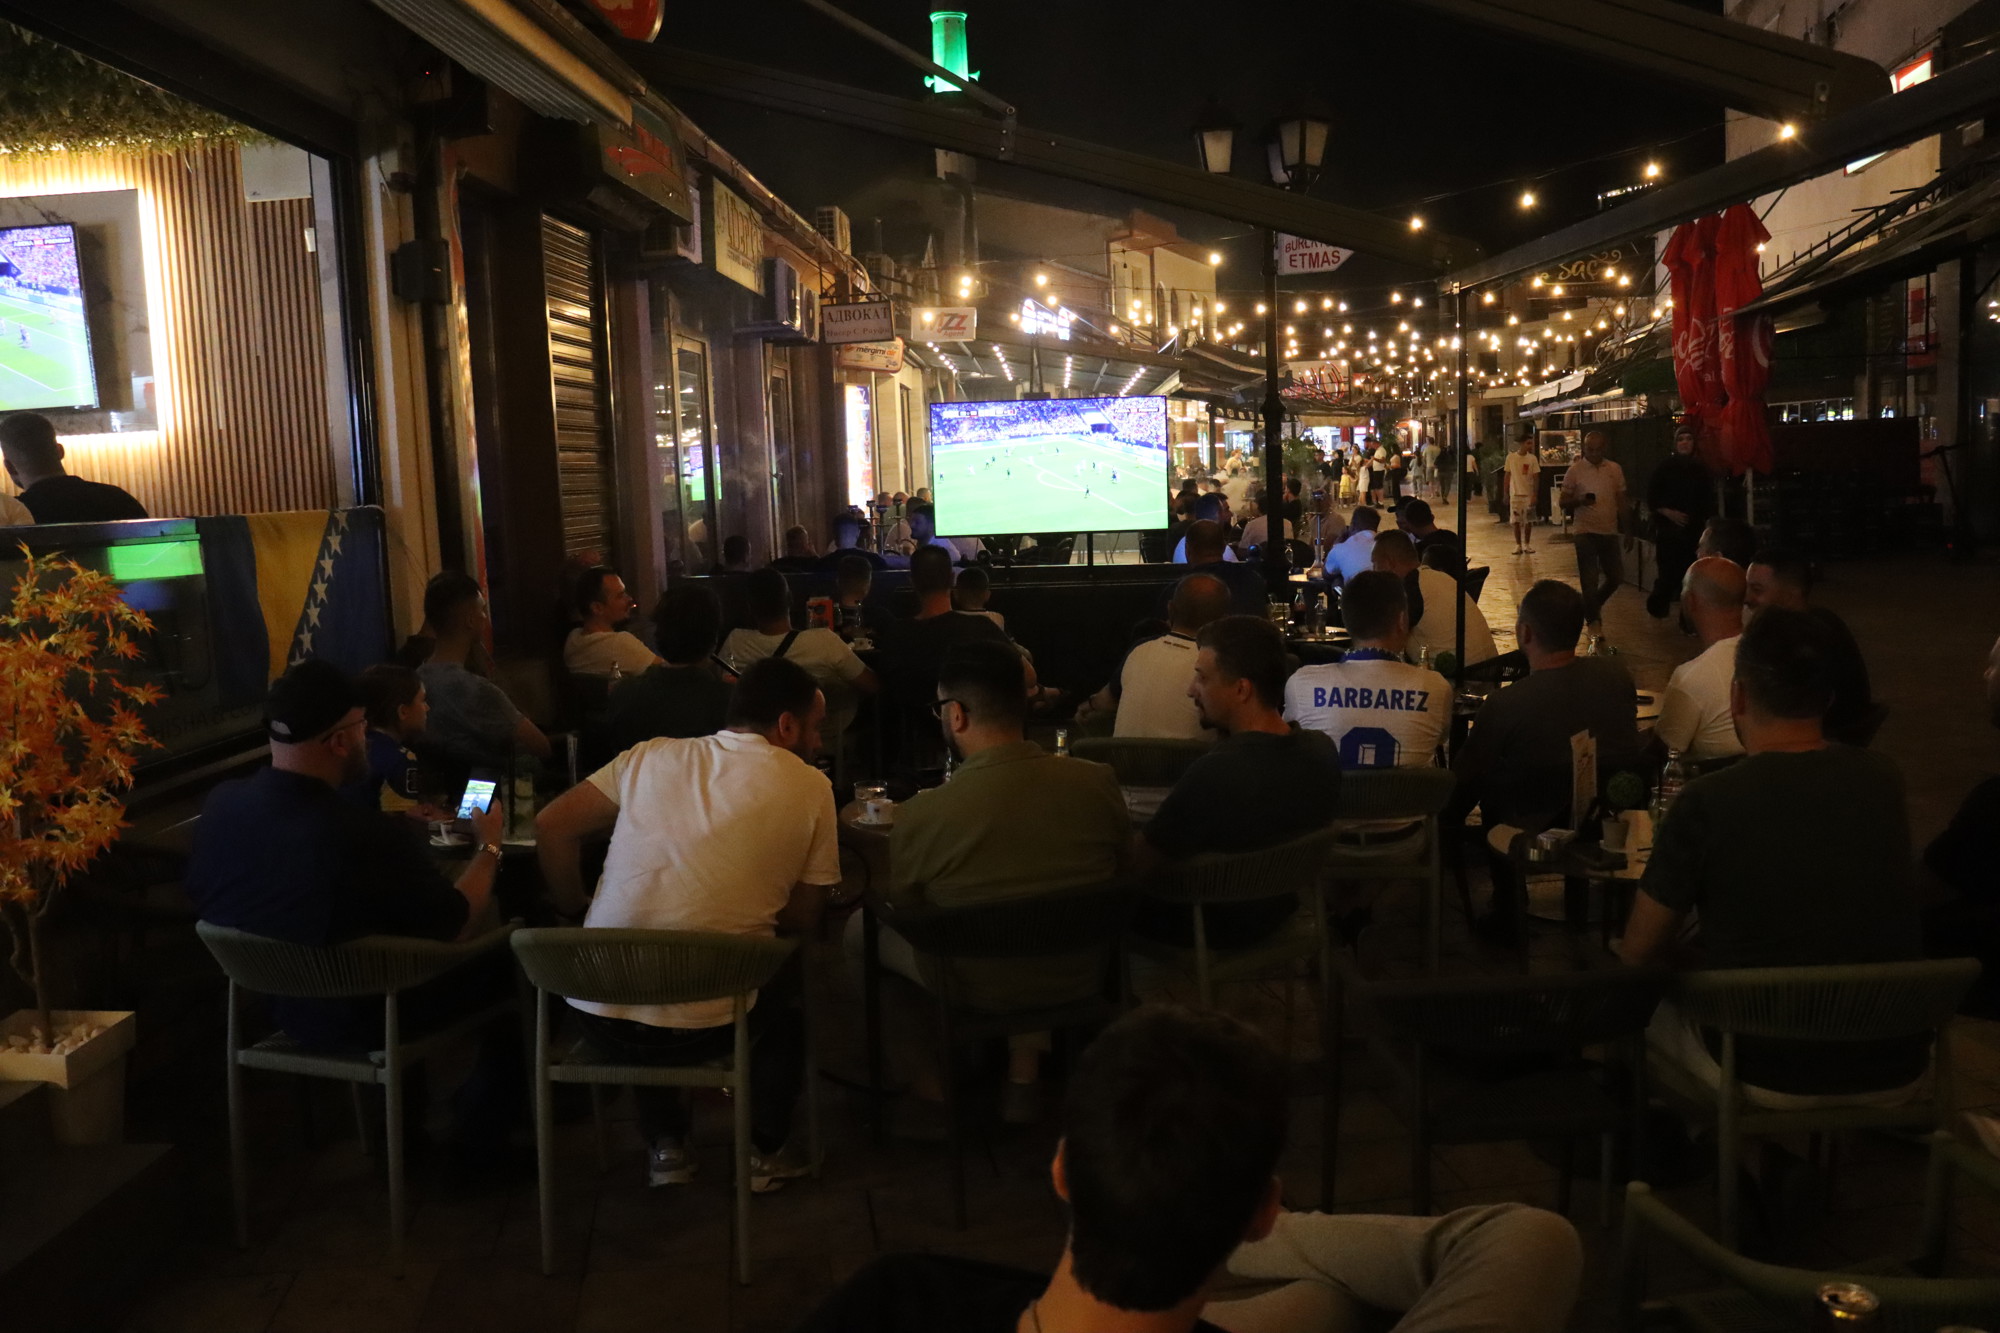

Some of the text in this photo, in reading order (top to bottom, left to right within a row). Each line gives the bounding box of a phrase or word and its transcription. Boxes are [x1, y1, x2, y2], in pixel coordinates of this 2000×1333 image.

[1289, 250, 1341, 269] ETMAS
[828, 307, 889, 324] АДВОКАТ
[1313, 686, 1430, 713] BARBAREZ
